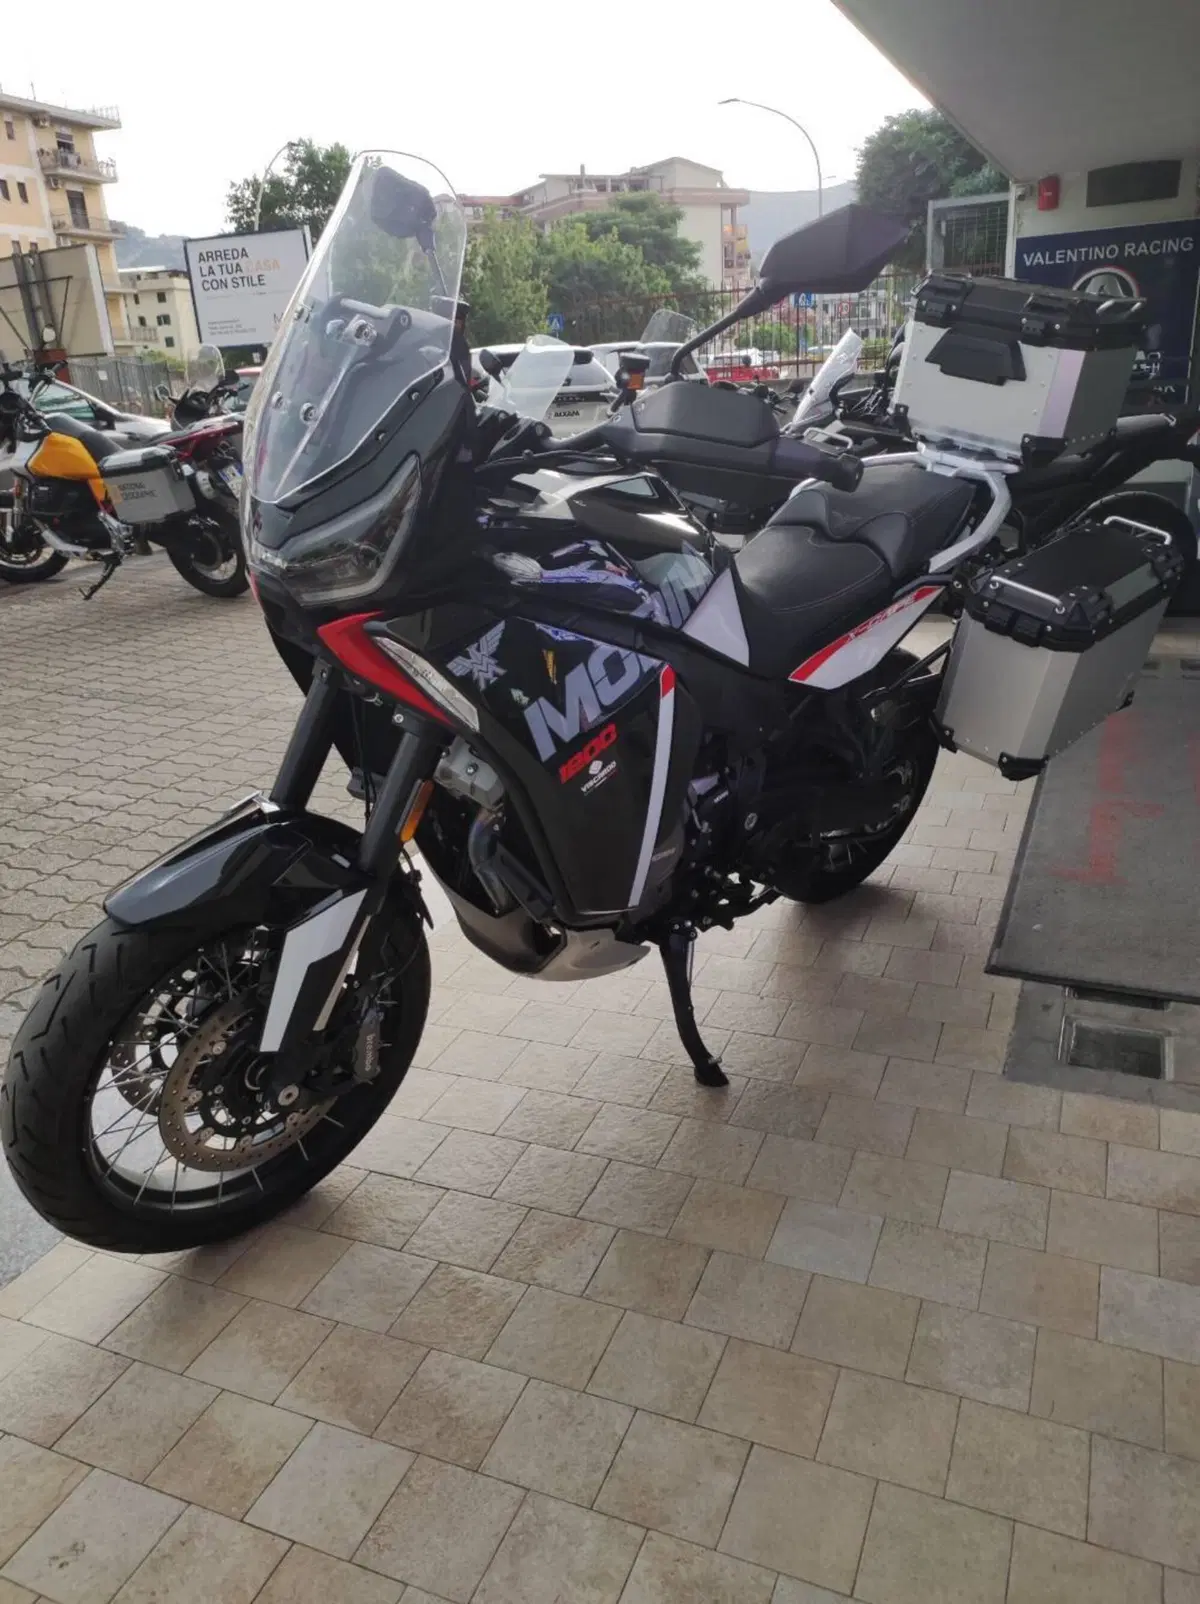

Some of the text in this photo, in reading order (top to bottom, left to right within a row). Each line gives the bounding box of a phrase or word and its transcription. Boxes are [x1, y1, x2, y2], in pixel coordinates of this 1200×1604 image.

[198, 247, 249, 263] ARREDA
[1022, 236, 1194, 267] VALENTINO RACING
[199, 265, 217, 277] LA
[219, 262, 243, 275] TUA
[201, 274, 266, 292] CON STILE
[523, 641, 664, 763] MO
